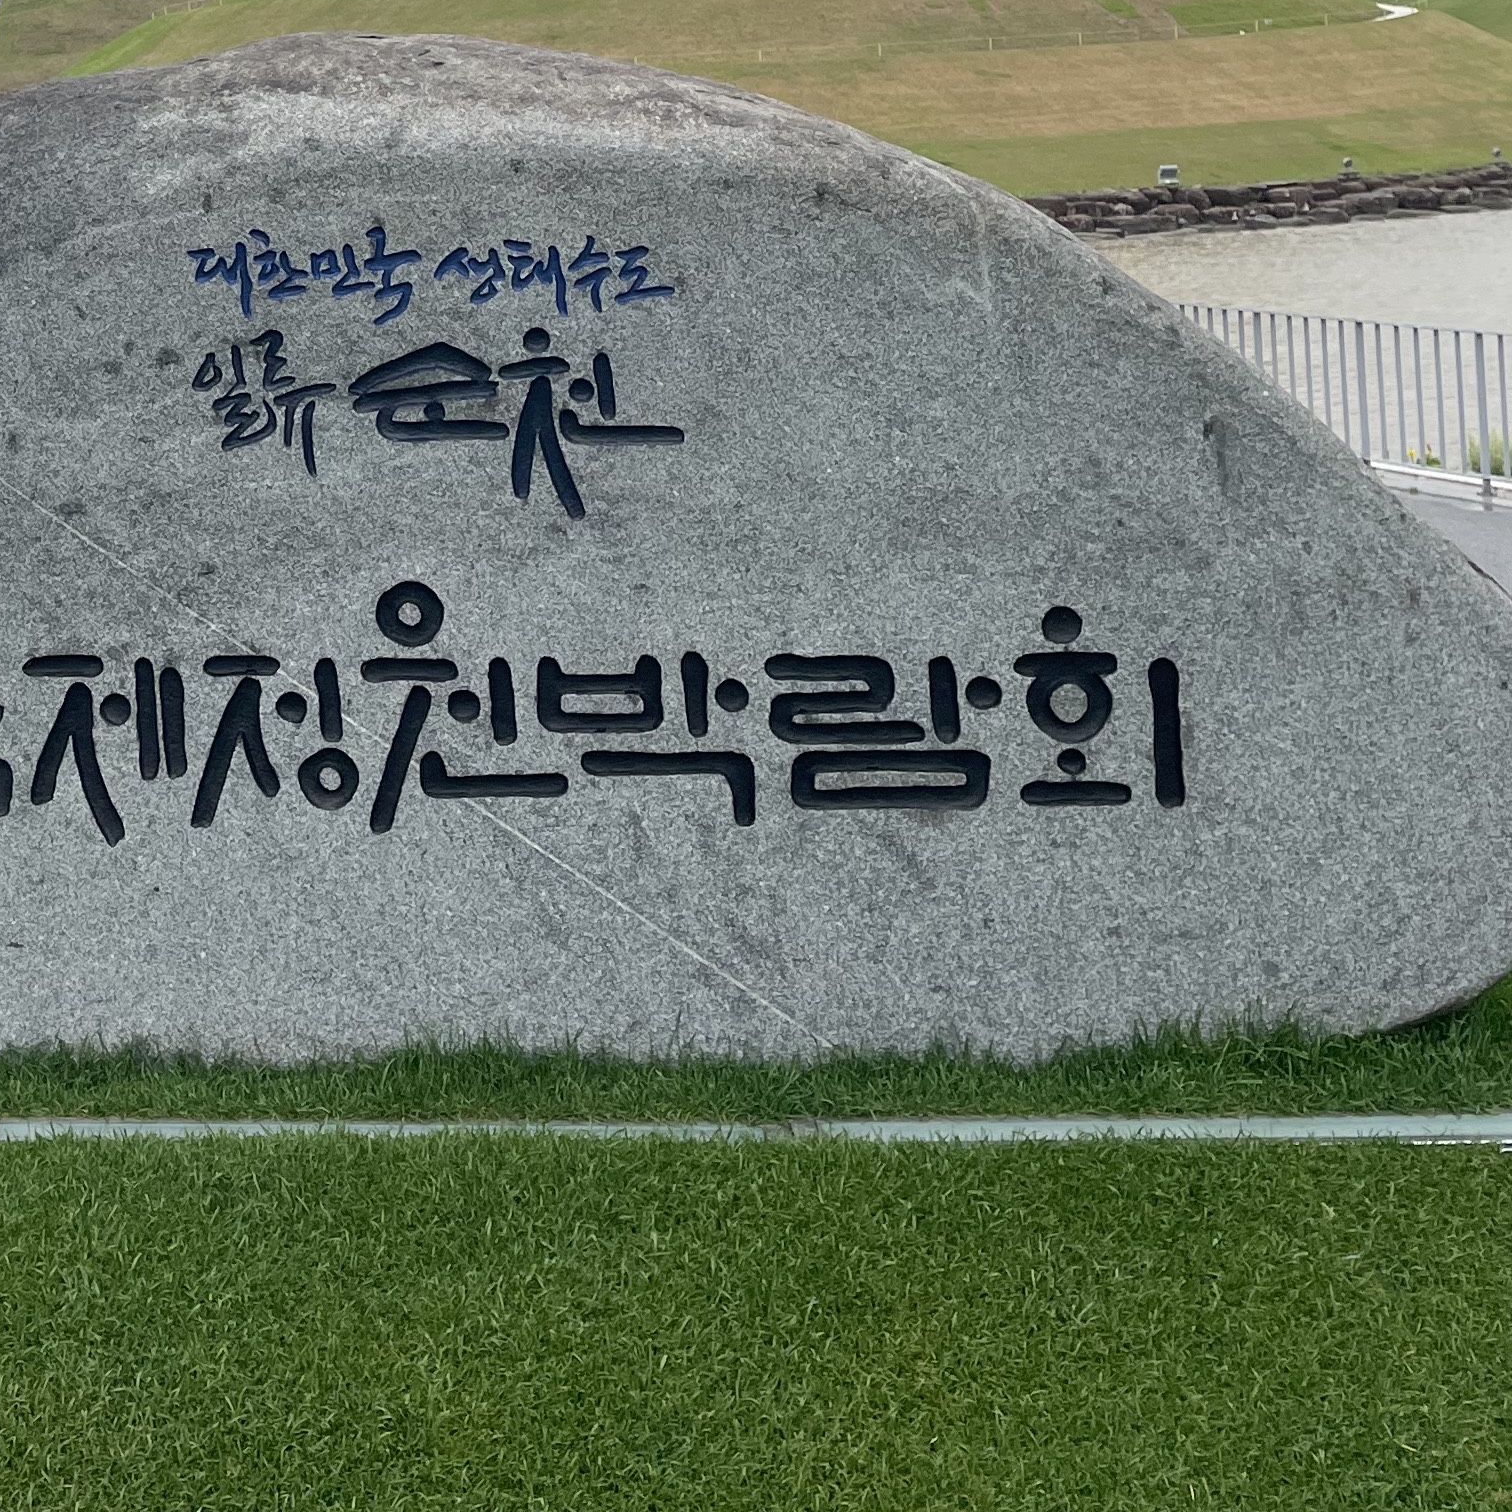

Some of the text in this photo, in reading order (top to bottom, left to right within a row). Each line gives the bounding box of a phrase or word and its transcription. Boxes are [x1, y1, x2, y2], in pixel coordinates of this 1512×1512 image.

[187, 226, 676, 326] 대한민국 생태수도
[191, 326, 685, 521] 일류 순천
